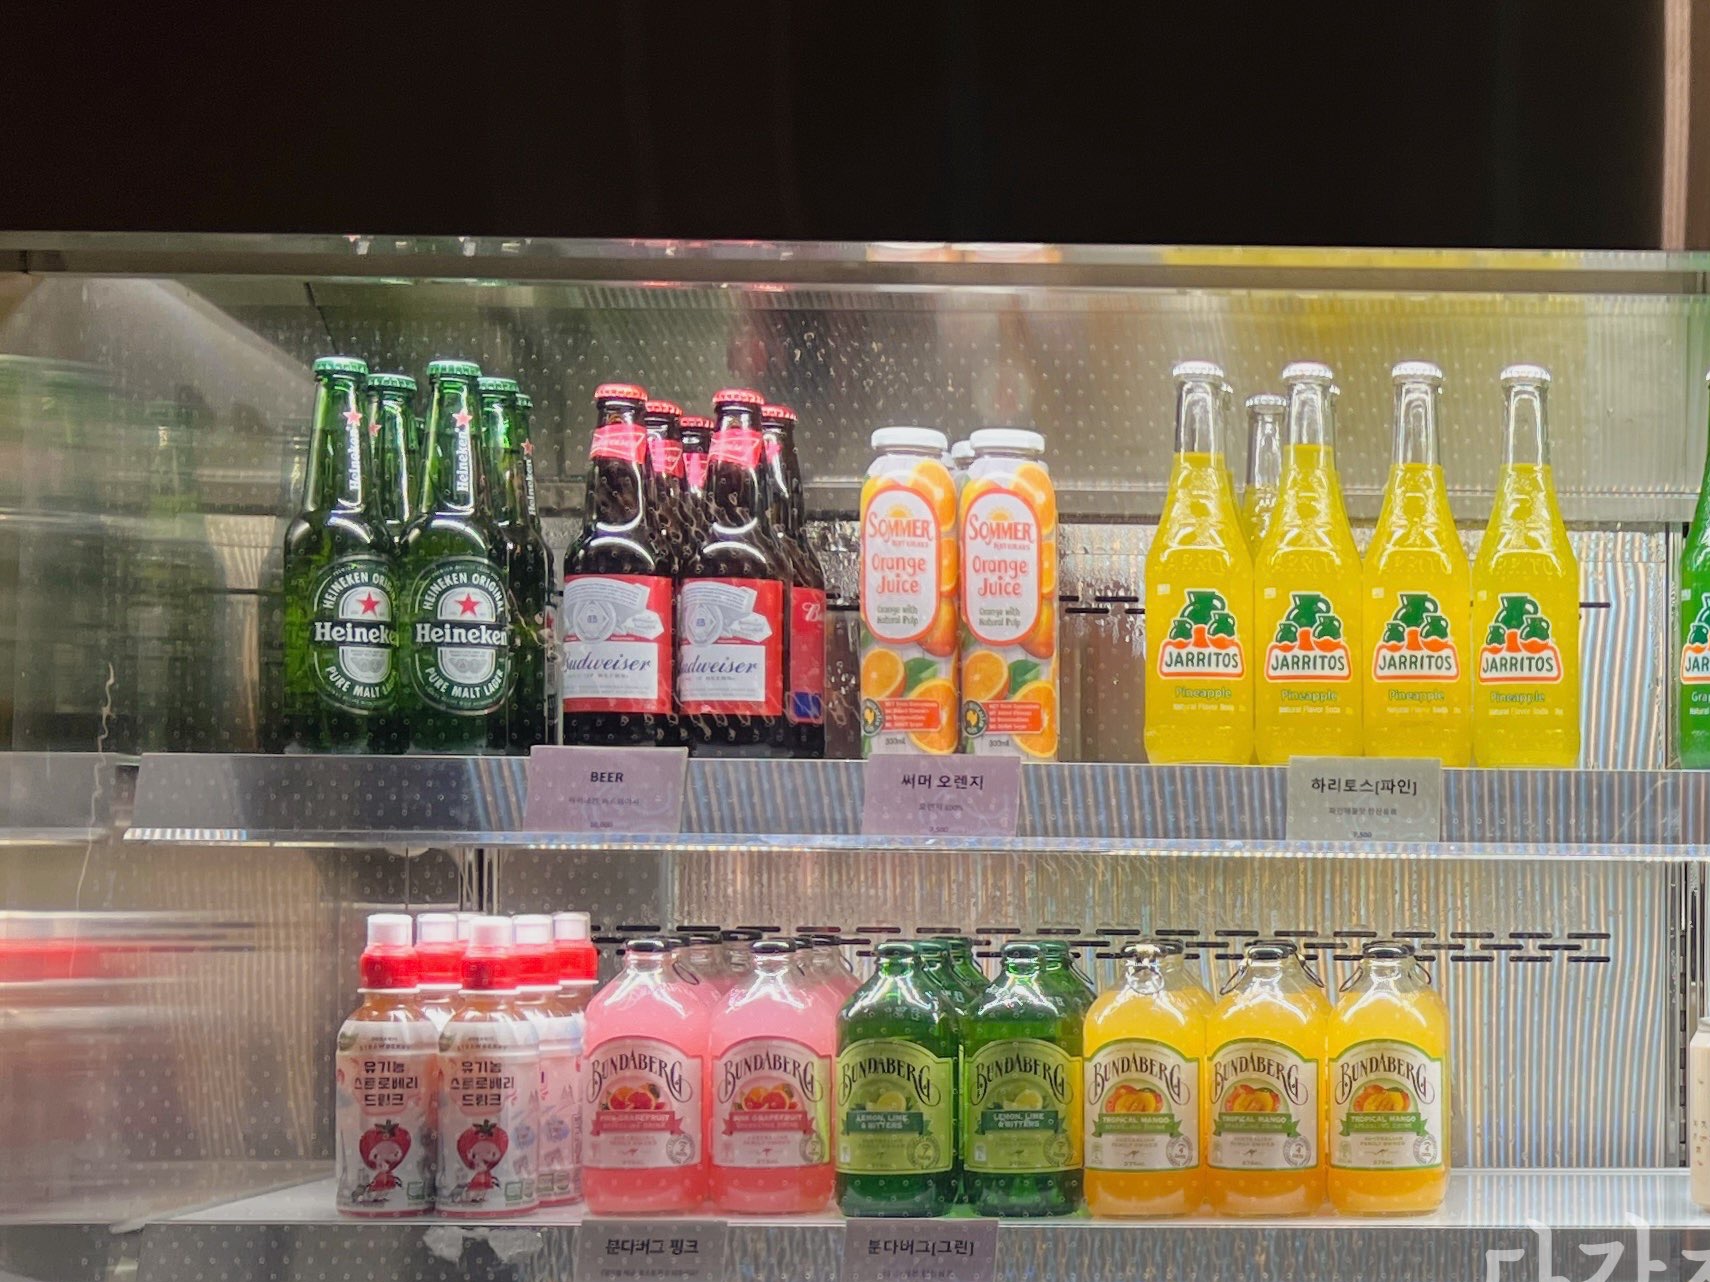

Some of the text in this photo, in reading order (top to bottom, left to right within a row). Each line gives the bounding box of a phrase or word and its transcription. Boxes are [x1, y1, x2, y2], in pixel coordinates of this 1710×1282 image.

[872, 553, 926, 575] Orange
[972, 556, 1027, 579] Orange
[323, 572, 369, 609] HEINEKEN
[423, 573, 504, 613] HEINEKEN ORIGINAL
[877, 573, 920, 594] Juice
[978, 575, 1021, 597] Juice
[315, 622, 399, 647] Heineke
[416, 622, 508, 646] Heineken
[680, 656, 758, 676] udweiser
[1165, 651, 1239, 668] JARRITOS
[1271, 654, 1345, 671] JARRITOS
[1379, 654, 1452, 671] JARRITOS
[1483, 656, 1554, 673] JARRITOS
[325, 665, 381, 698] PURE MALT
[425, 667, 447, 693] PURE
[451, 685, 481, 699] MALT
[590, 772, 624, 783] BEER
[901, 773, 985, 791] 써머 오렌지
[1311, 777, 1418, 796] 하리토스[파인]
[364, 1060, 405, 1074] 유기농
[461, 1060, 502, 1074] 유기농
[587, 1048, 693, 1104] BUNDABERG
[718, 1048, 824, 1104] BUNDABERG
[354, 1076, 418, 1090] 스트로베리
[451, 1076, 515, 1090] 스트로베리
[838, 1056, 941, 1106] BUNDABERG
[971, 1053, 1074, 1106] BUNDABERG
[1088, 1051, 1191, 1106] BUNDABERG
[1210, 1051, 1309, 1106] BUNDABERG
[1334, 1051, 1436, 1106] BUNDABERG
[364, 1093, 405, 1107] 드링크
[461, 1093, 502, 1107] 드링크
[670, 1238, 699, 1256] 핑크
